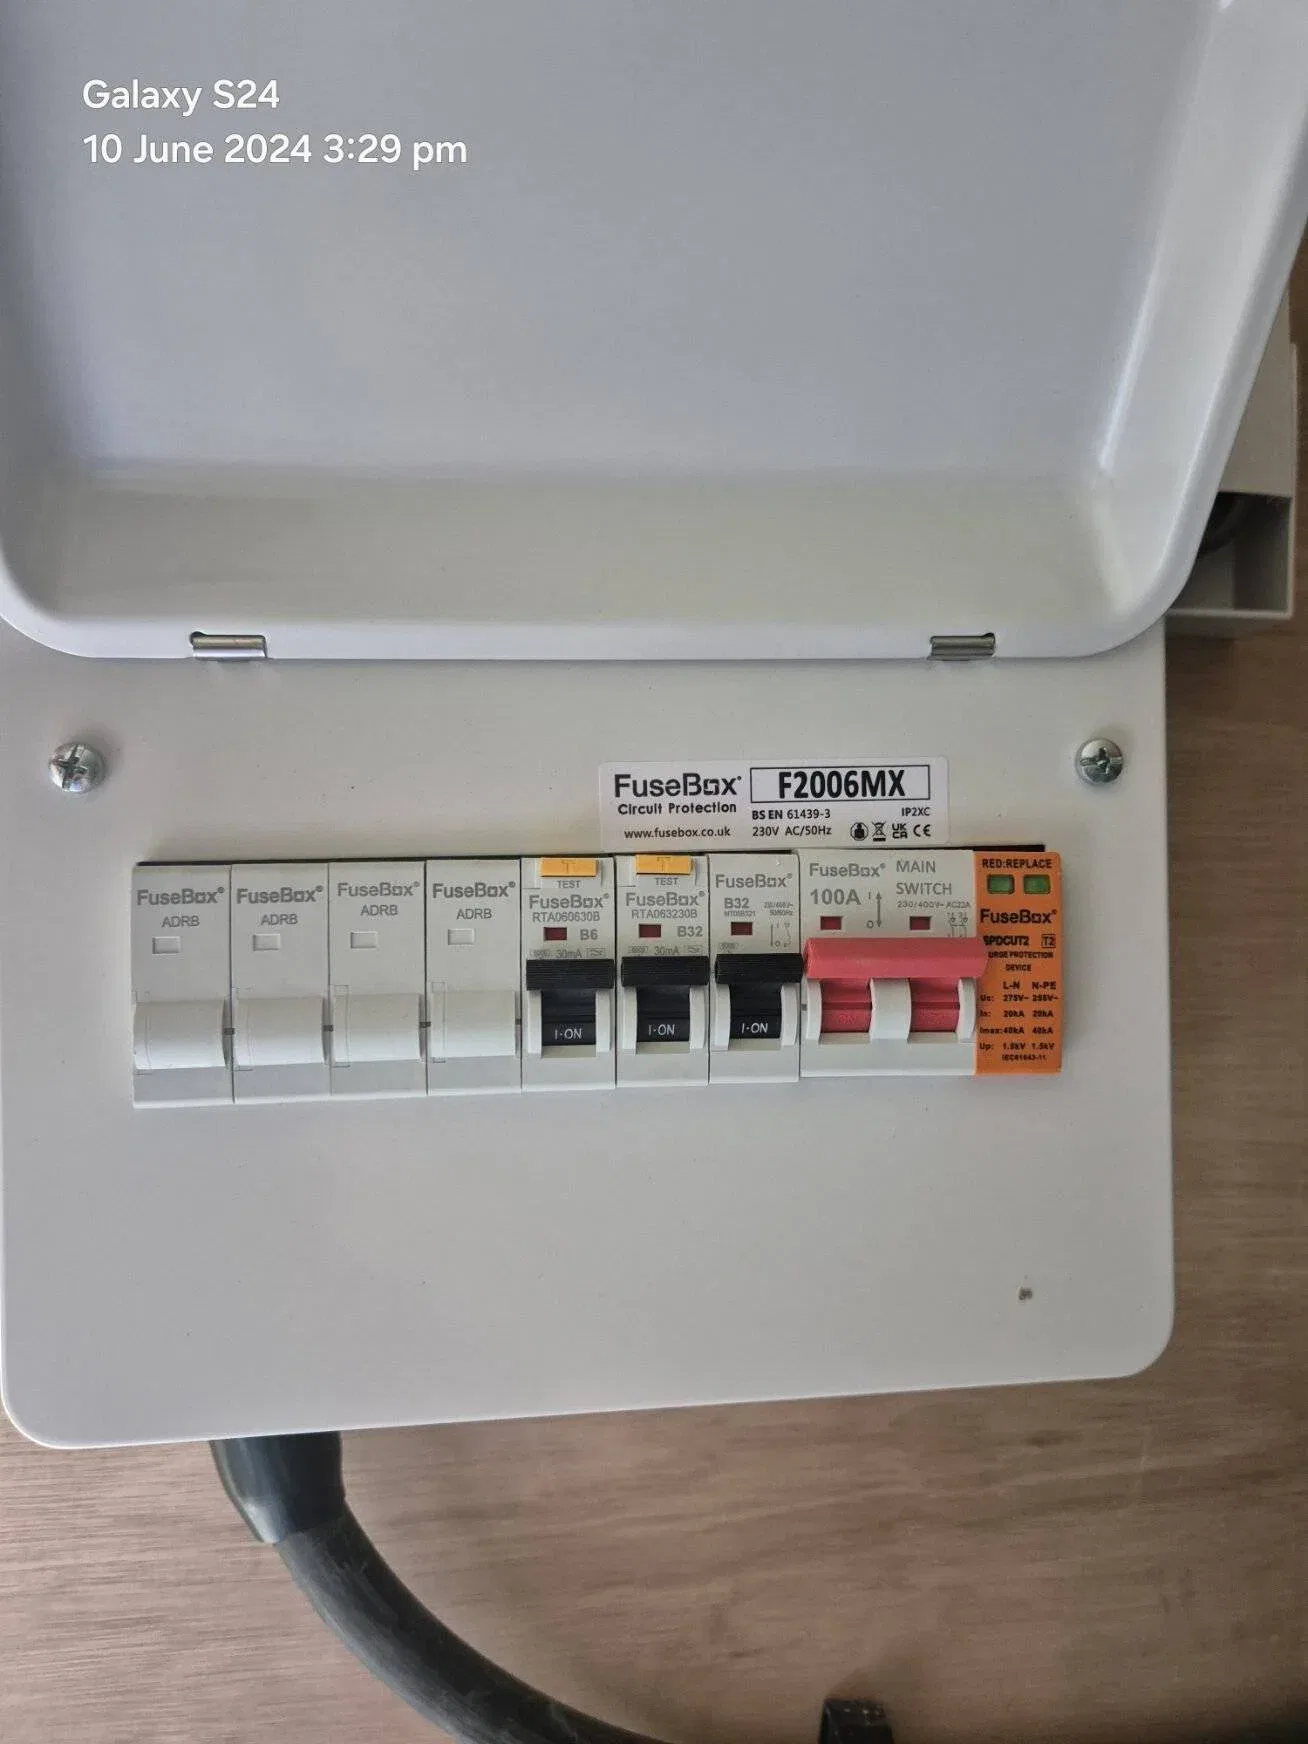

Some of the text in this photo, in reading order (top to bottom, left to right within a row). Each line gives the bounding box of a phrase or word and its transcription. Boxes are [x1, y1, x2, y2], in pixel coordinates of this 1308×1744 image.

[778, 770, 905, 799] F2006MX
[617, 802, 737, 815] Circuit Protection
[752, 808, 830, 820] BS EN 61439-3
[901, 807, 930, 817] IP2XC
[624, 826, 730, 839] www.fusebox.co.uk
[752, 825, 831, 837] 230V AC/50Hz
[896, 861, 936, 873] MAIN
[982, 859, 1052, 868] RED:REPLACE
[557, 880, 581, 888] TEST
[896, 883, 952, 895] SWITCH
[724, 898, 749, 908] B32
[810, 889, 861, 905] 100A
[360, 903, 398, 916] ADRB
[456, 908, 492, 920] ADRB
[161, 914, 200, 928] ADRB
[261, 913, 298, 926] ADRB
[580, 929, 598, 940] B6
[677, 926, 703, 937] B32
[1032, 982, 1056, 990] N-PE
